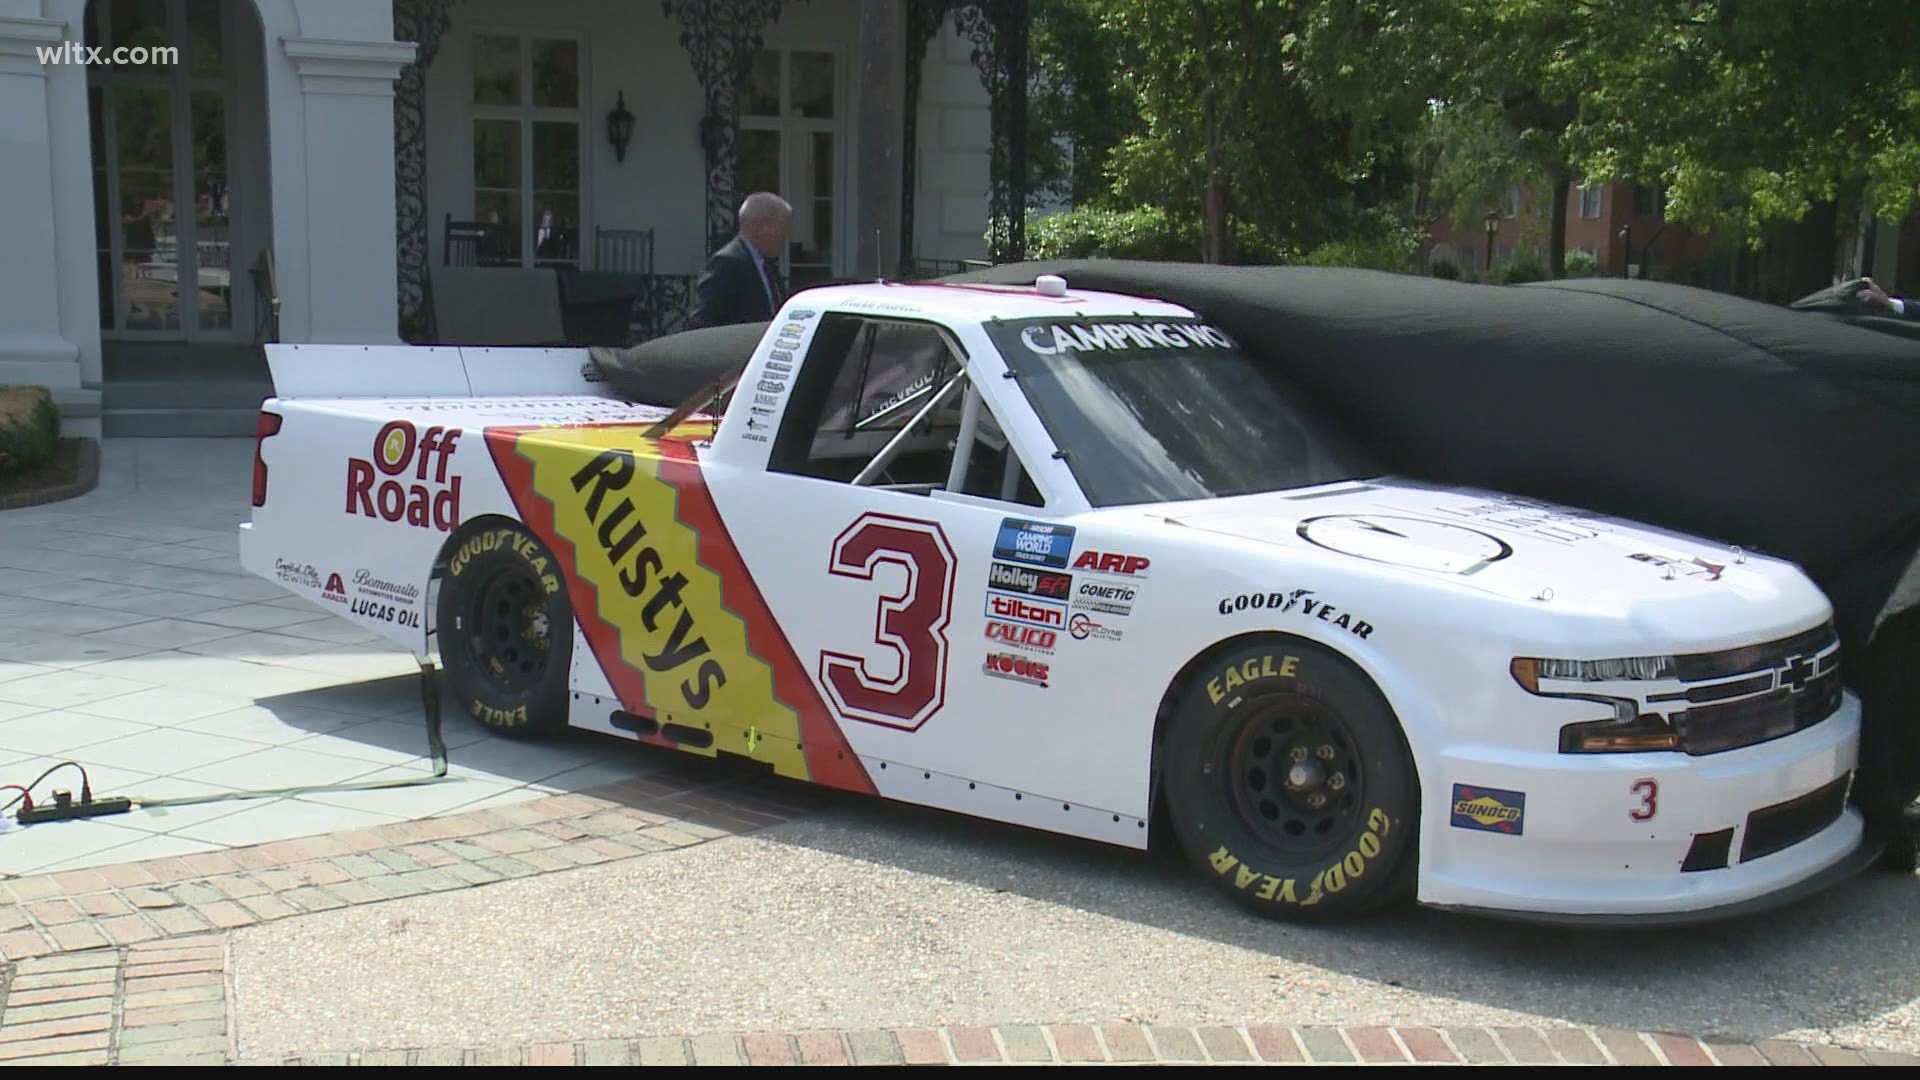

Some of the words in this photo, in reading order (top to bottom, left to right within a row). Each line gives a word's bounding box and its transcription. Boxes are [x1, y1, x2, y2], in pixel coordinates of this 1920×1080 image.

[1020, 322, 1190, 355] CAMPING
[1173, 323, 1232, 349] WO
[373, 420, 464, 484] Off
[345, 458, 462, 533] Road
[450, 529, 560, 595] GOODYEAR
[1015, 539, 1051, 554] WORLD
[1072, 550, 1151, 574] ARP
[352, 568, 420, 599] Bommarito
[571, 448, 727, 711] Rustys
[990, 563, 1039, 593] Holley
[1079, 582, 1136, 602] COMETIC
[321, 592, 349, 604] AXALTA
[351, 597, 395, 622] LUCAS
[398, 609, 421, 629] OIL
[991, 597, 1062, 625] tilton
[1218, 588, 1374, 640] GOODYEAR
[818, 511, 958, 734] 3
[984, 620, 1057, 649] CALICO
[1206, 655, 1300, 705] EAGLE
[470, 699, 528, 728] EAGLE
[1454, 801, 1521, 821] SUNOCO
[1628, 777, 1660, 824] 3
[1207, 807, 1391, 906] GOODYEAR
